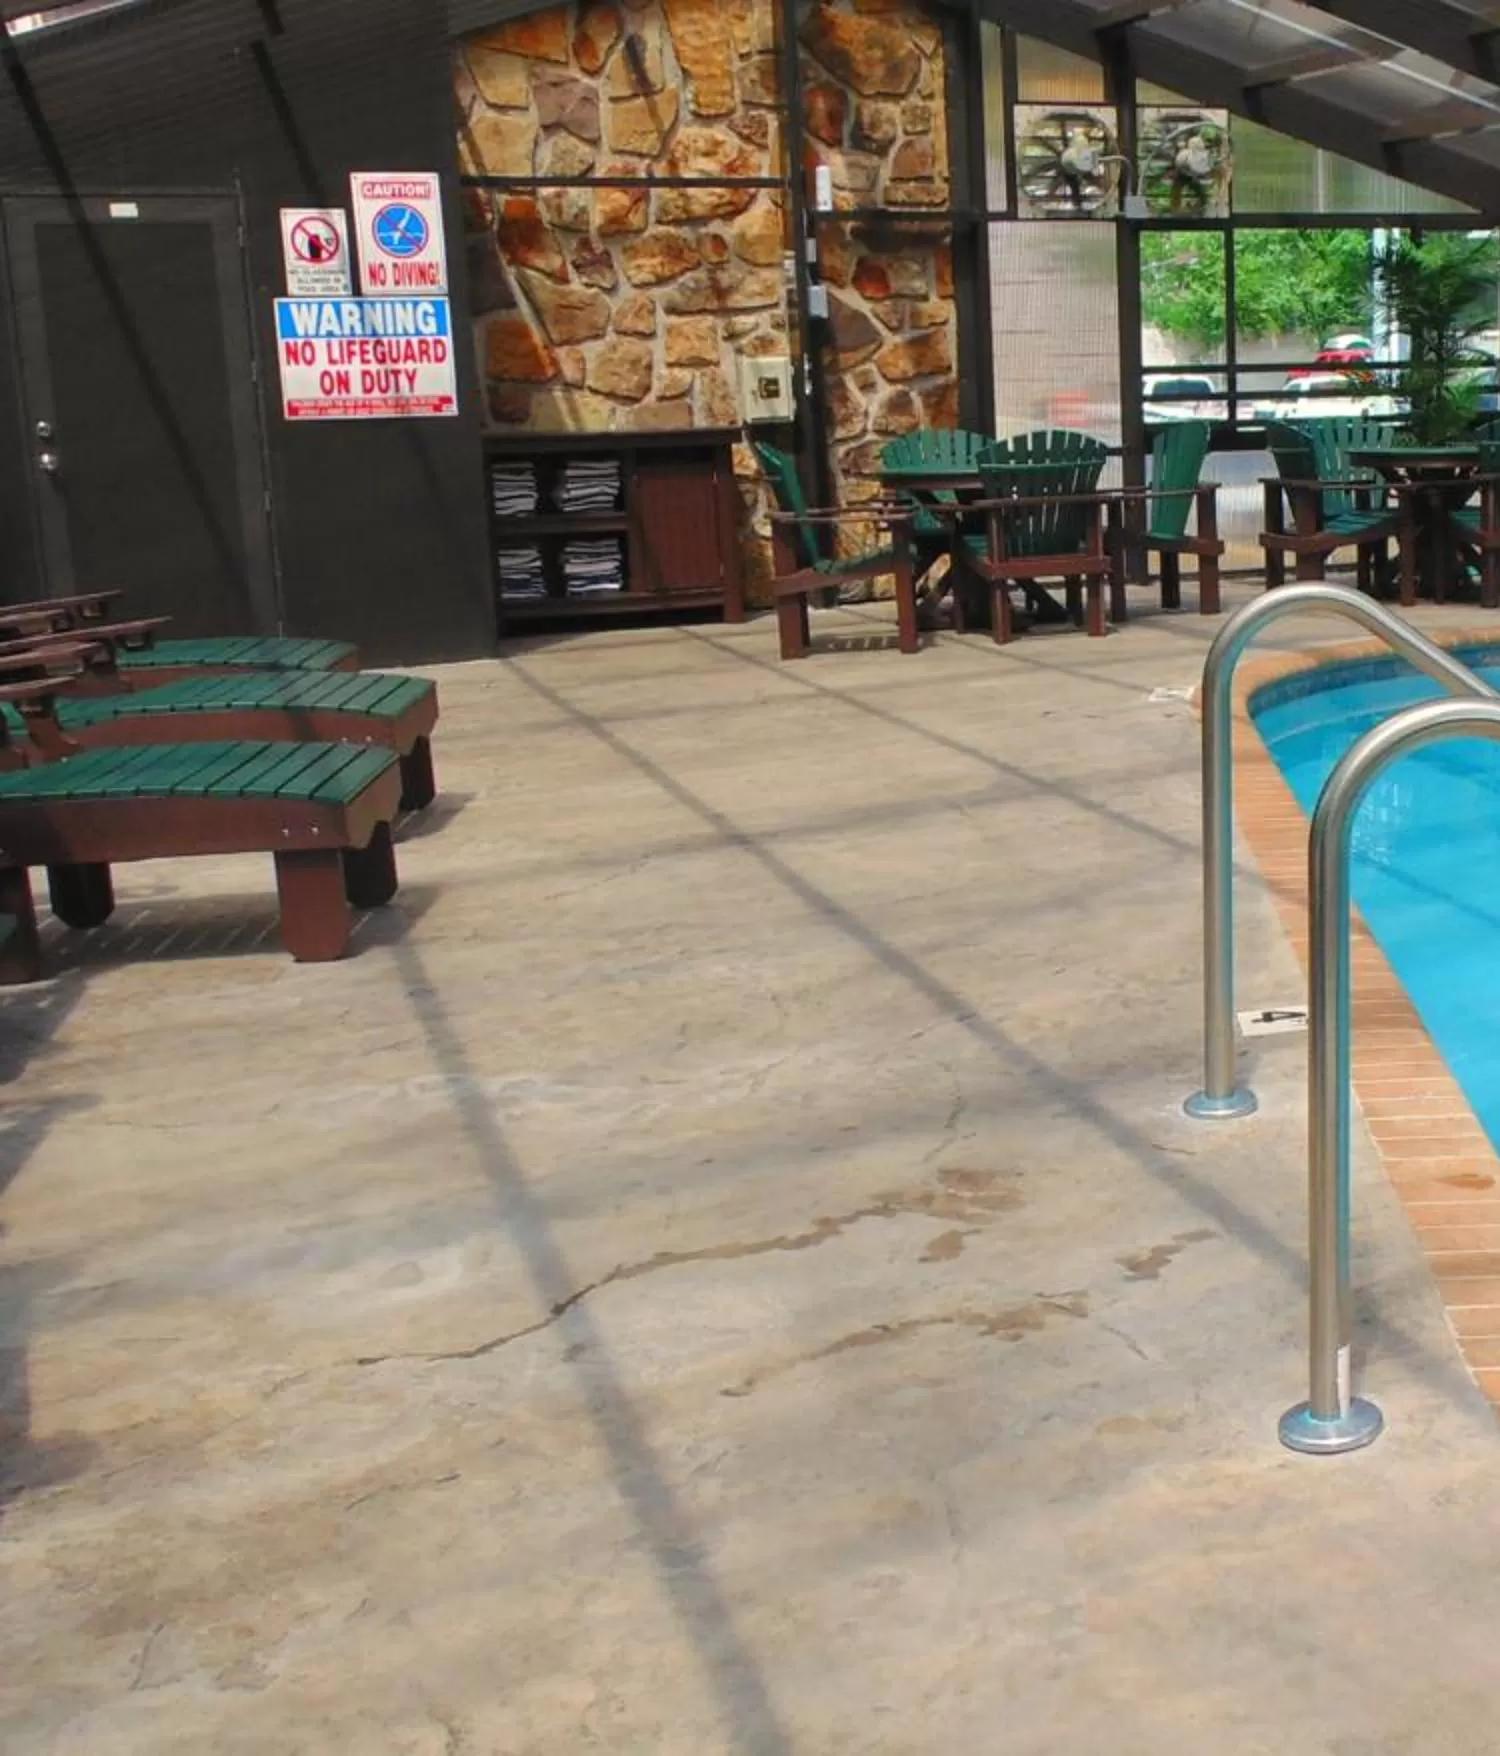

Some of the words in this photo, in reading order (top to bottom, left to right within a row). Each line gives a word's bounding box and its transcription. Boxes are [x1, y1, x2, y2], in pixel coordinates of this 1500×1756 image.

[363, 182, 430, 198] CAUTION!
[368, 263, 386, 288] NO
[392, 263, 440, 286] DIVING!
[290, 302, 437, 335] WARNING
[285, 340, 316, 366] NO
[327, 338, 447, 365] LIFEGUARD
[320, 370, 350, 395] ON
[361, 369, 417, 395] DUTY
